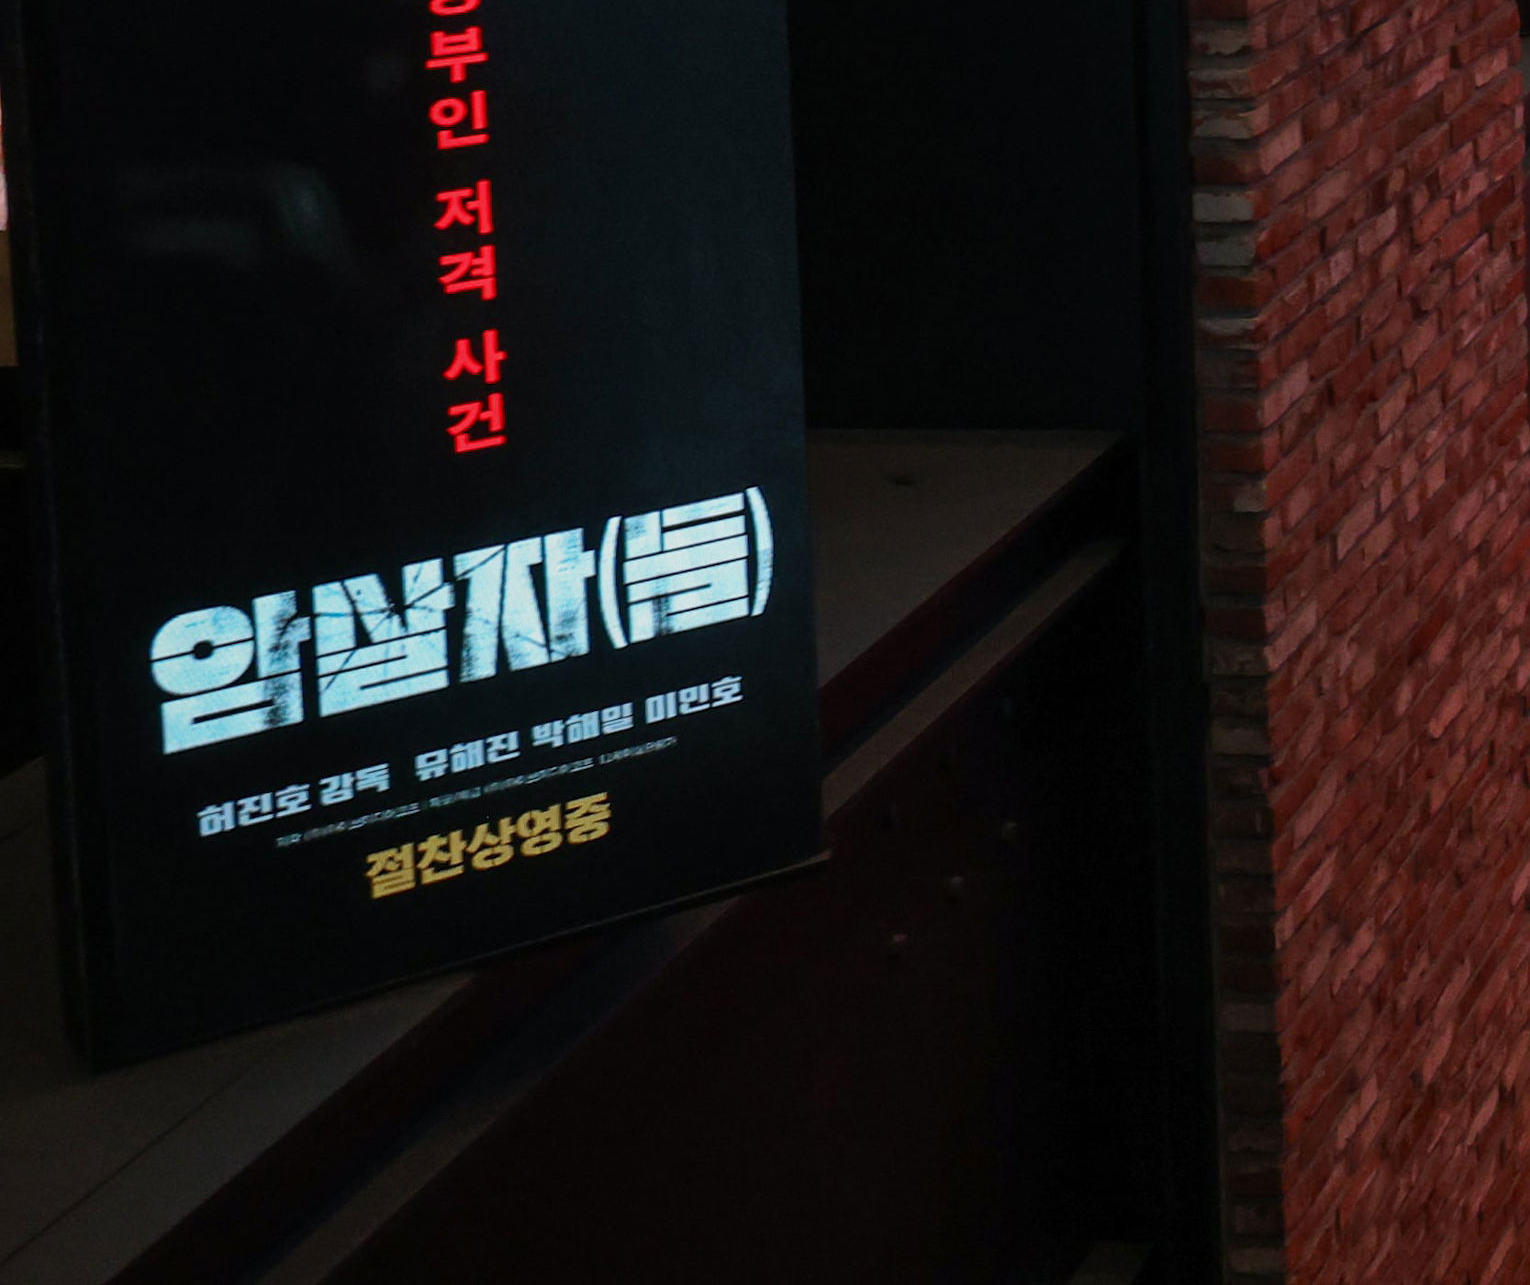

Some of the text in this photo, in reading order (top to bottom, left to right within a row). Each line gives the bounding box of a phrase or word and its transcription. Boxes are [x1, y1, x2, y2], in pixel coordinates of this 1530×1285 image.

[433, 178, 498, 302] 저격
[442, 328, 508, 454] 사건
[149, 486, 774, 754] 암살자(들)
[197, 783, 312, 837] 허진호
[318, 763, 391, 807] 감독
[414, 730, 521, 782] 유해진
[531, 702, 634, 749] 박해일
[644, 675, 744, 725] 이민호
[366, 792, 612, 900] 절찬상영중
